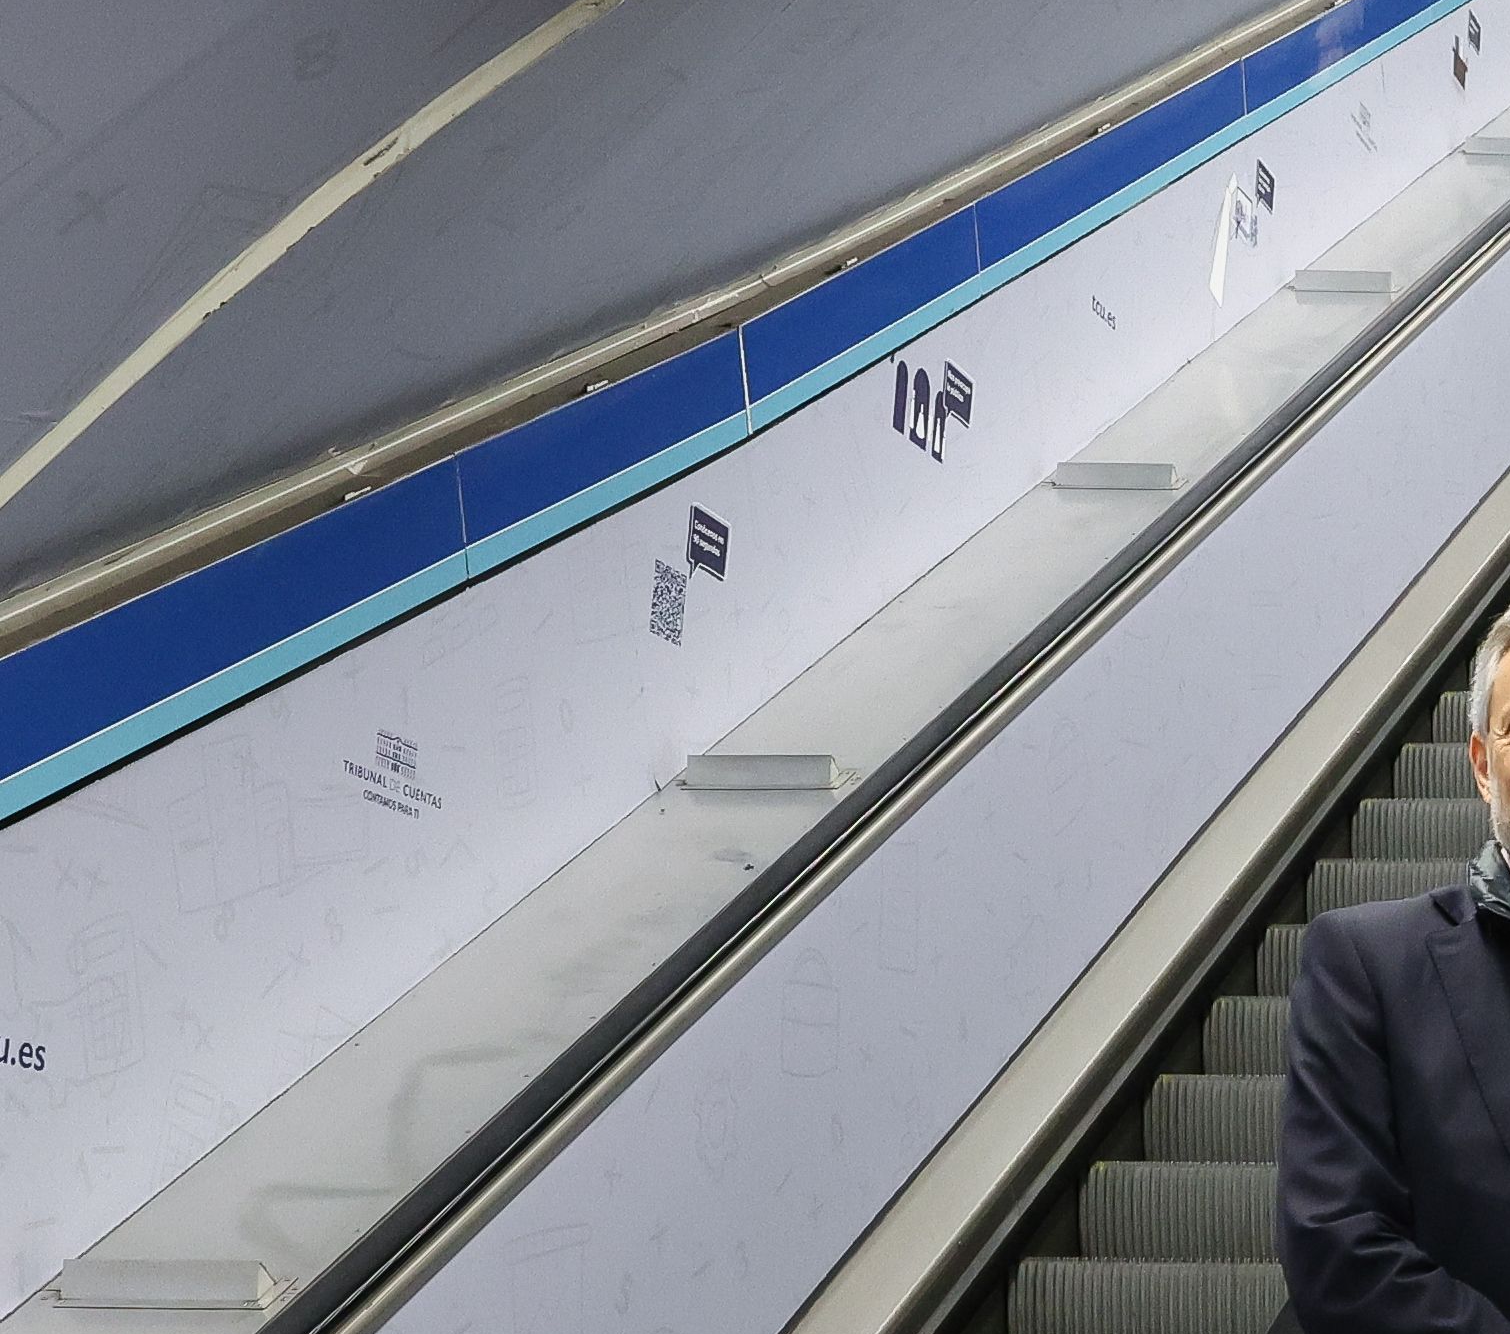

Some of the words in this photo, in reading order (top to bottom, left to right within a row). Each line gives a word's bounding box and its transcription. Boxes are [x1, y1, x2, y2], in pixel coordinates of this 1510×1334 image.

[1092, 294, 1116, 330] tcu.es
[343, 759, 388, 788] TRIBUNAL
[402, 783, 443, 810] CUENTAS
